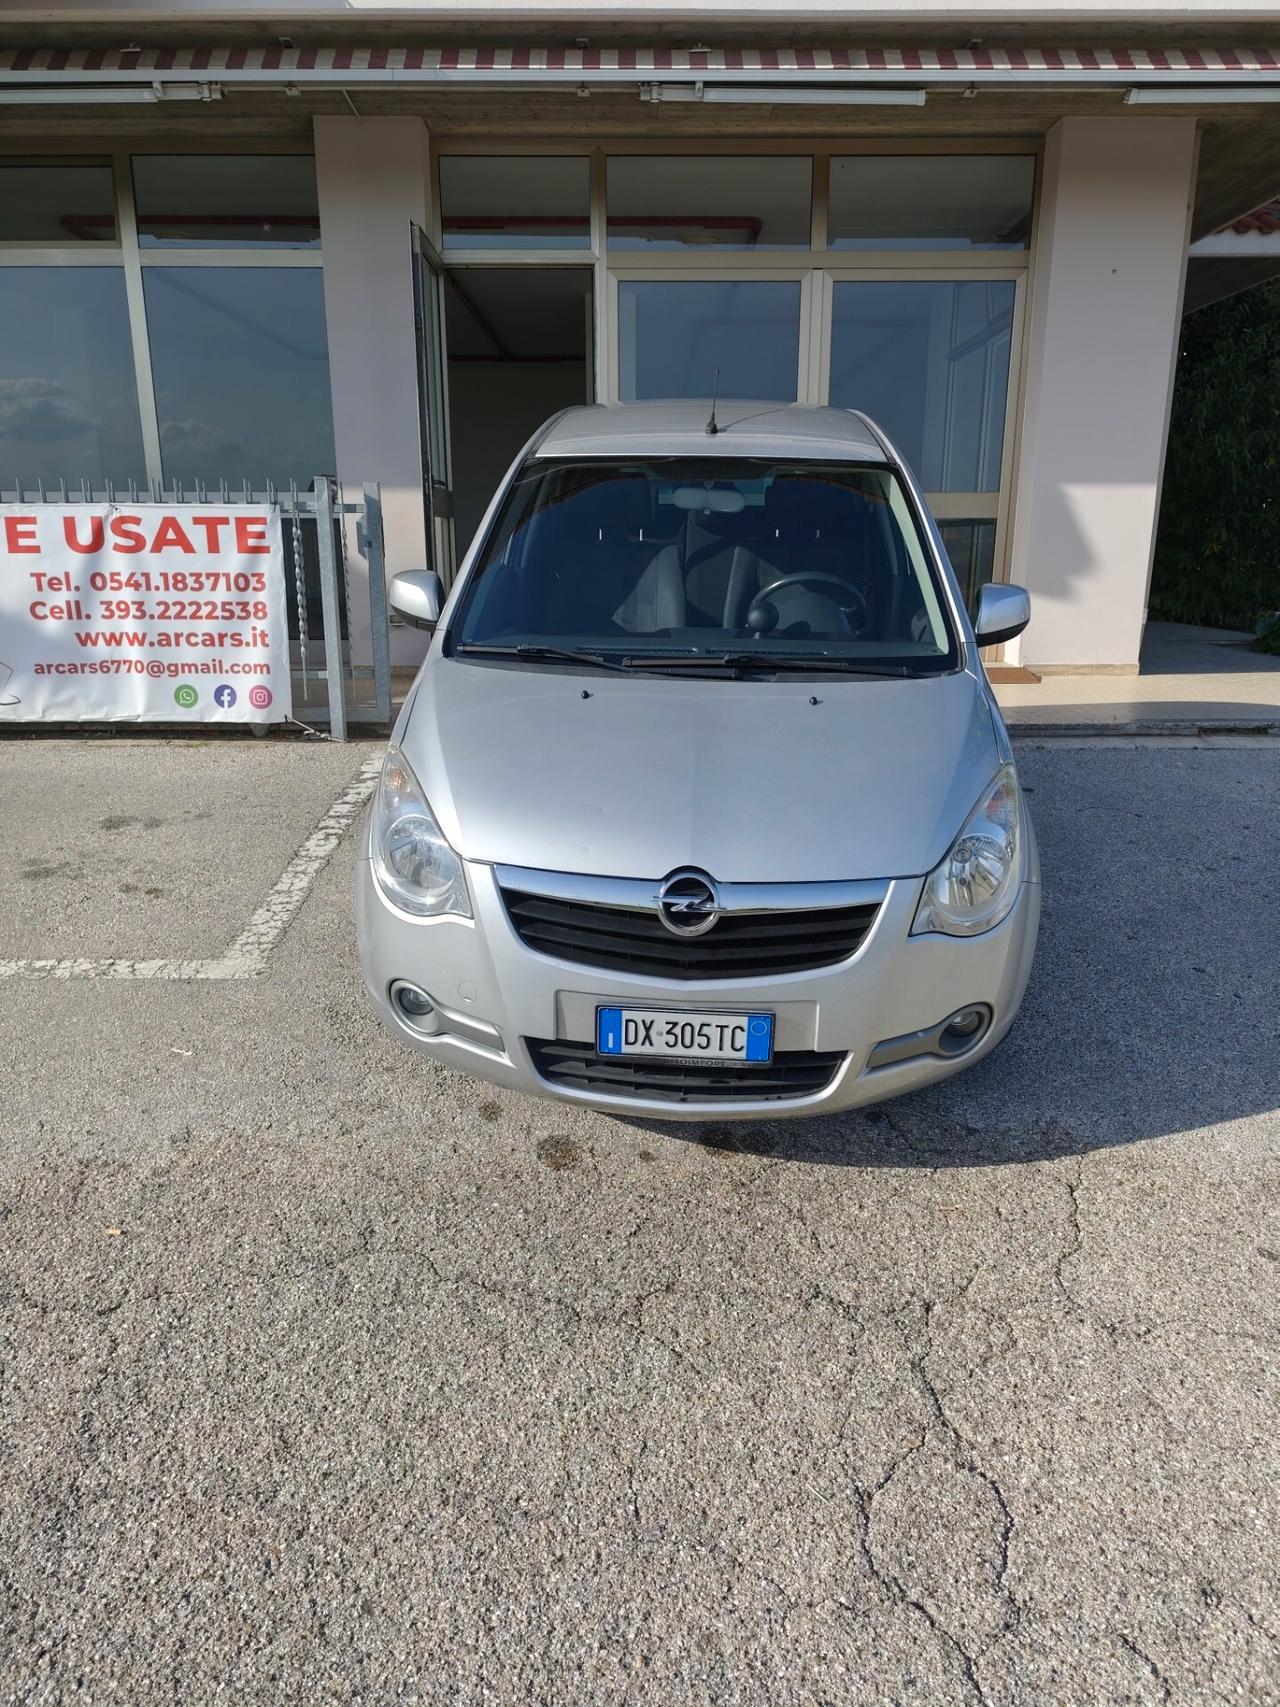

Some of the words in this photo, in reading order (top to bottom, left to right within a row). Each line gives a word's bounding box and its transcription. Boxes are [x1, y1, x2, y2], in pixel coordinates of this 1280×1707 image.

[63, 515, 271, 554] USATE
[30, 571, 81, 592] Tel.
[90, 571, 266, 592] 0541.1837103
[29, 600, 92, 620] Cell.
[99, 600, 268, 620] 393.2222538
[74, 626, 270, 648] www.arcars.it
[34, 658, 271, 678] arcars6770@gmail.com
[624, 1018, 655, 1047] DX
[664, 1020, 745, 1052] 305TC
